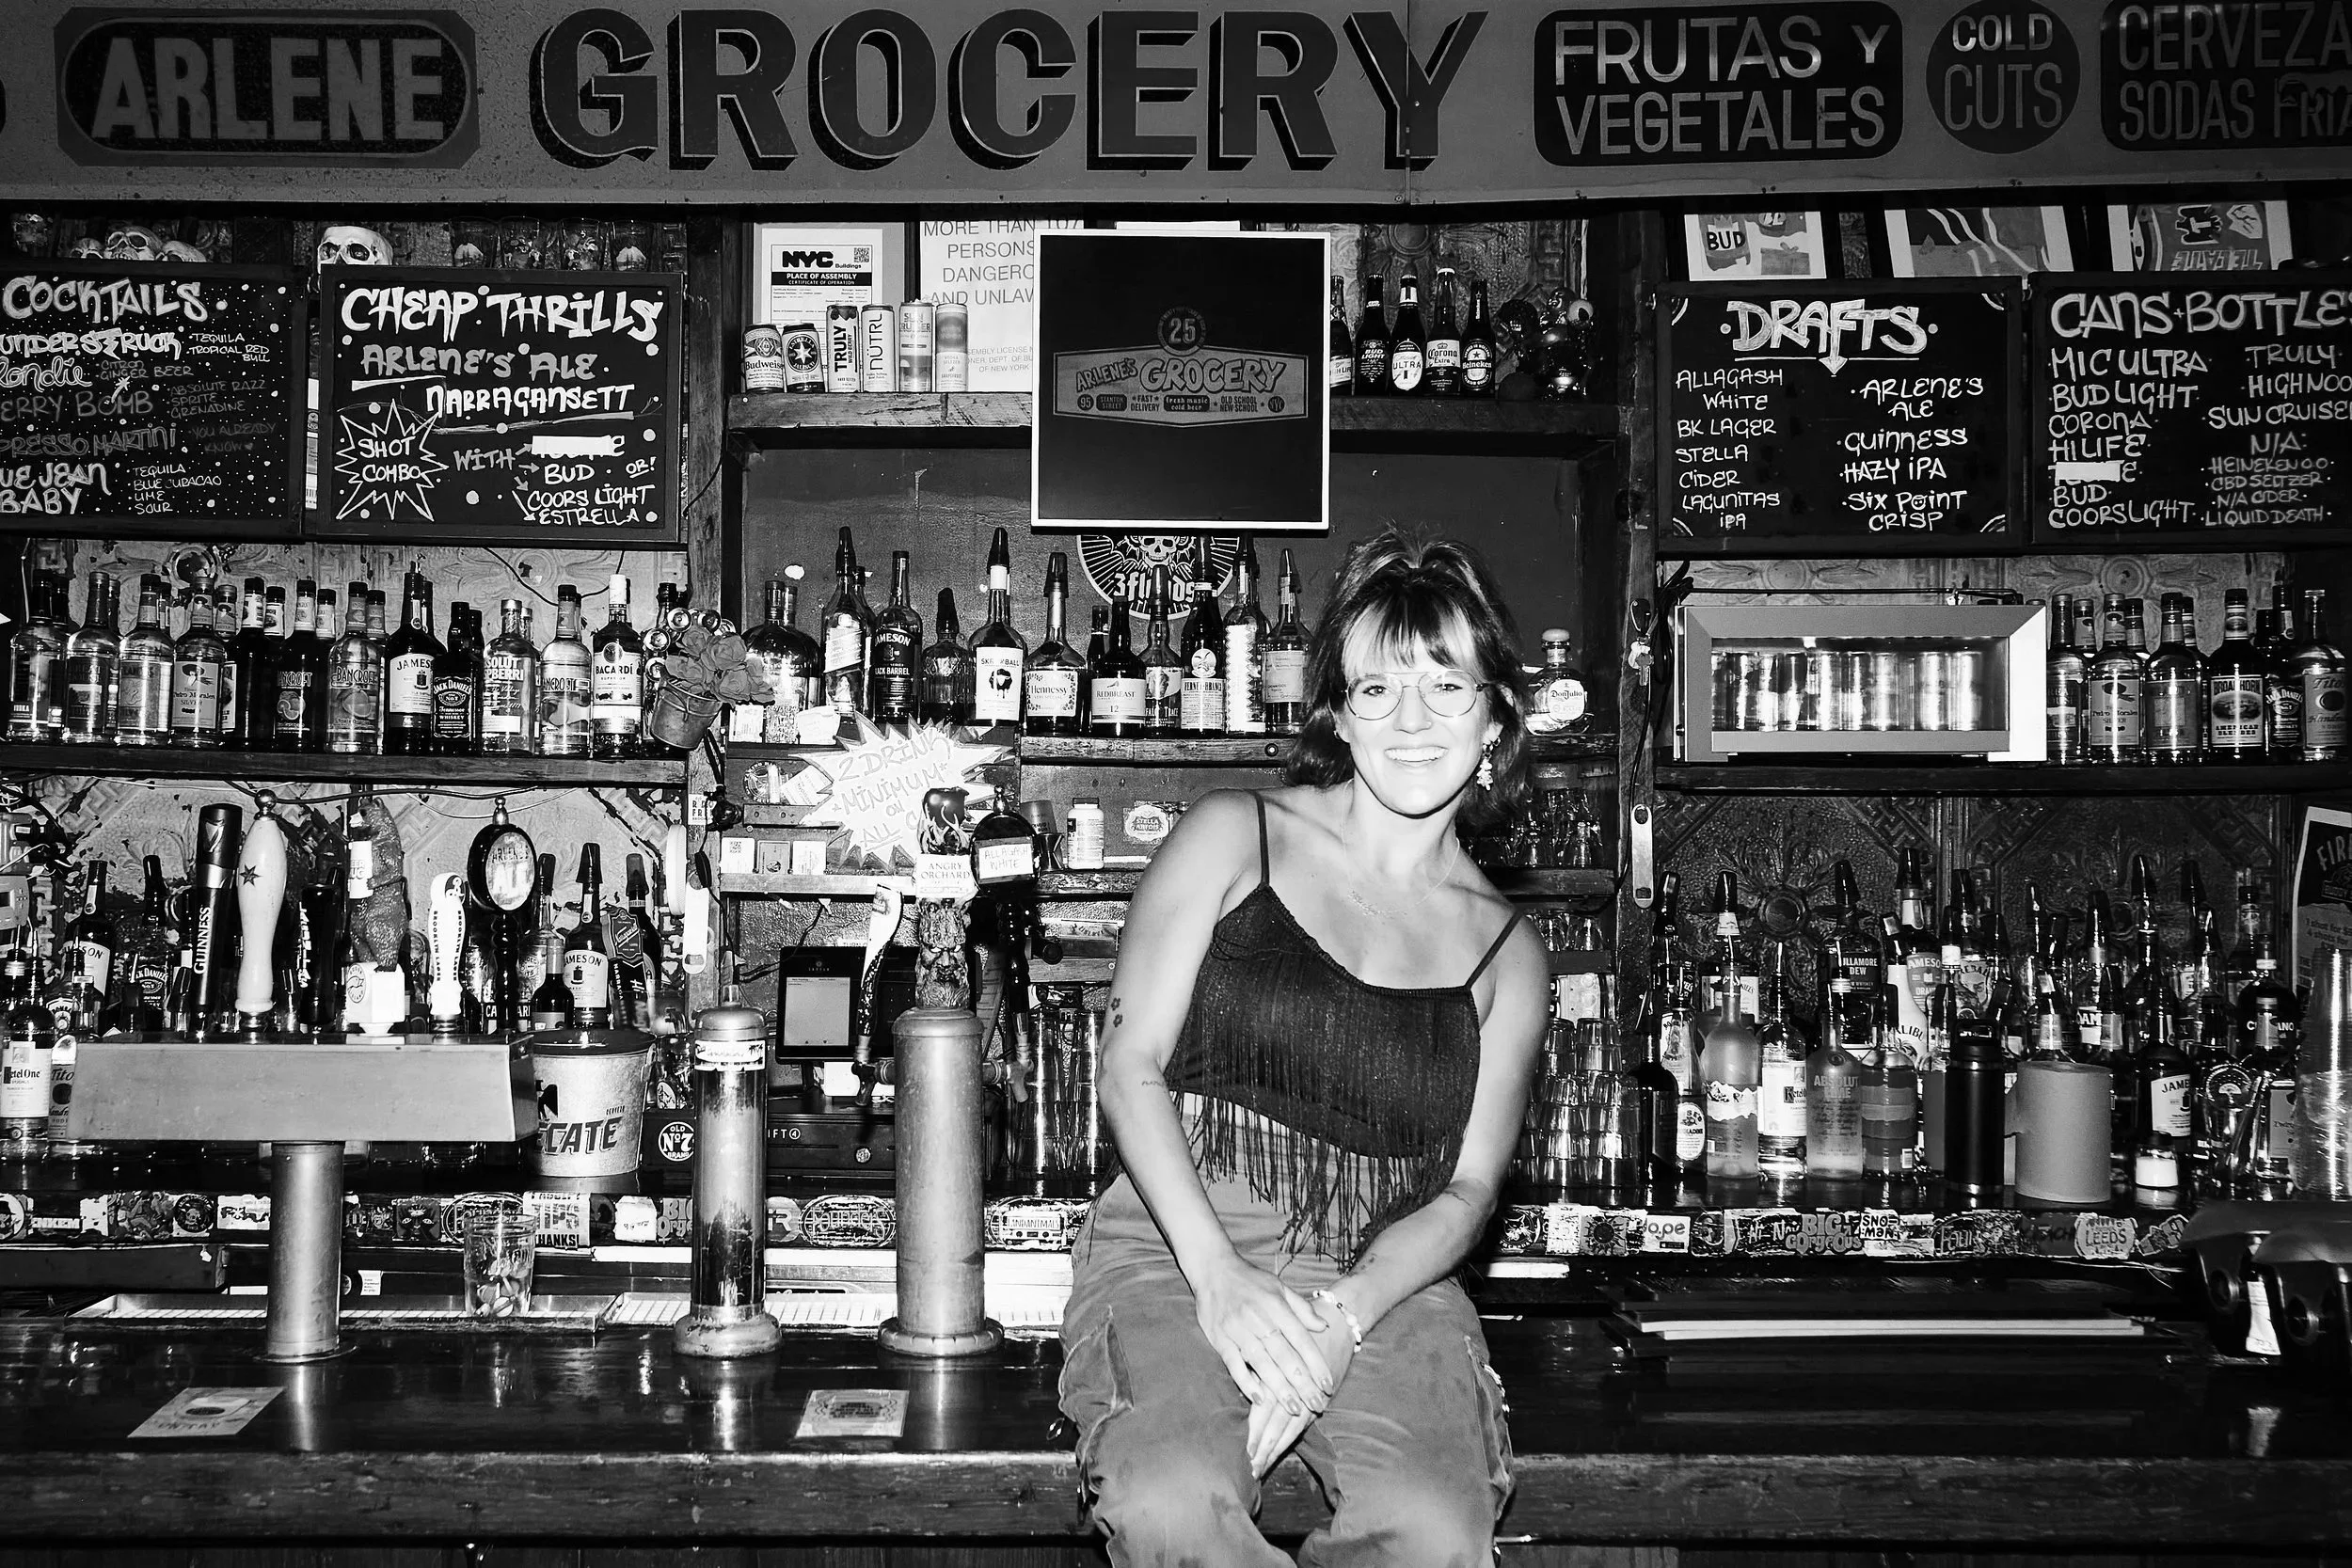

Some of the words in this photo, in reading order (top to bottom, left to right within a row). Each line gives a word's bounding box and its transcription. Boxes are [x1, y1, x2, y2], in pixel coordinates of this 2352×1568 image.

[1952, 13, 2053, 52] COLD
[1555, 14, 1821, 85] FRUTAS
[1852, 24, 1891, 64] Y
[94, 38, 444, 140] ARLENE
[529, 8, 1489, 171] GROCERY
[1944, 61, 2063, 132] CUTS
[2120, 78, 2255, 141] SODAS
[1557, 87, 1885, 155] VEGETALES
[924, 221, 979, 236] MORE
[1706, 230, 1746, 251] BUD
[782, 251, 834, 268] NYC
[931, 292, 968, 305] AND
[342, 287, 478, 342] CHEAP
[486, 290, 663, 342] THRILLS
[191, 333, 246, 342] TEQUILA
[1170, 317, 1196, 343] 25
[1727, 299, 1927, 357] DRAFTS
[188, 345, 243, 355] TROPICAL
[245, 345, 270, 355] RED
[243, 354, 270, 362] BULL
[834, 325, 848, 372] TRULY
[1428, 348, 1457, 359] Corona
[2245, 343, 2337, 369] TRULY
[101, 370, 148, 380] GINGER
[153, 365, 195, 378] BEER
[528, 353, 598, 384] ALE
[1392, 361, 1422, 370] ULTRA
[2051, 347, 2111, 381] MIC
[2119, 348, 2208, 378] ULTRA
[1076, 357, 1138, 393] ARLENE'S
[1139, 357, 1287, 394] GROCERY
[1676, 369, 1784, 392] ALLAGASH
[75, 390, 153, 418] BOMB
[170, 393, 217, 405] SPRITE
[1079, 395, 1092, 409] 95
[1220, 396, 1232, 404] OLD
[1233, 396, 1257, 404] SCHOOL
[1269, 398, 1283, 411] NYC
[1703, 393, 1769, 411] WHITE
[2052, 384, 2109, 412] BUD
[2115, 380, 2199, 414] LIGHT
[170, 402, 246, 420] GRENADINE
[1131, 404, 1160, 412] DELIVERY
[1219, 404, 1232, 412] NEW
[1233, 404, 1258, 412] SCHOOL
[1888, 400, 1933, 421] ALE
[2208, 404, 2260, 429] SUN
[1677, 420, 1704, 437] BK
[1710, 419, 1777, 438] LAGER
[2048, 410, 2152, 438] CORONA
[358, 436, 416, 457] SHOT
[1675, 445, 1749, 463] STELLA
[133, 464, 186, 475] TEQUILA
[362, 465, 421, 483] COMBO
[1844, 458, 1900, 485] HAZY
[2208, 456, 2298, 473] HEINEKEN
[544, 464, 595, 485] BUD
[1678, 470, 1740, 488] CIDER
[2211, 476, 2247, 491] CBD
[2249, 472, 2323, 487] SELTZER
[134, 480, 163, 491] BLUE
[0, 487, 82, 515] BABY
[134, 491, 166, 501] LIME
[527, 490, 588, 508] COORS
[595, 483, 655, 507] LIGHT
[2052, 484, 2108, 508] BUD
[2217, 494, 2248, 509] N/A
[135, 502, 174, 515] SOUR
[539, 508, 640, 527] ESTRELLA
[2204, 509, 2269, 529] LIQUID
[2270, 505, 2323, 524] DEATH
[433, 683, 449, 694] JACK
[1550, 690, 1564, 699] Don
[1564, 689, 1583, 700] Julio
[838, 756, 861, 782] 2
[858, 733, 950, 777] DRINK
[886, 800, 903, 816] ON
[860, 823, 900, 847] ALL
[985, 848, 1029, 860] ALLAGASH
[921, 870, 970, 879] ORCHARD
[991, 860, 1020, 871] WHITE
[194, 907, 212, 974] GUINNESS
[1850, 967, 1867, 975] DEW
[24, 1069, 40, 1078] One
[1803, 1213, 1841, 1236] BIG
